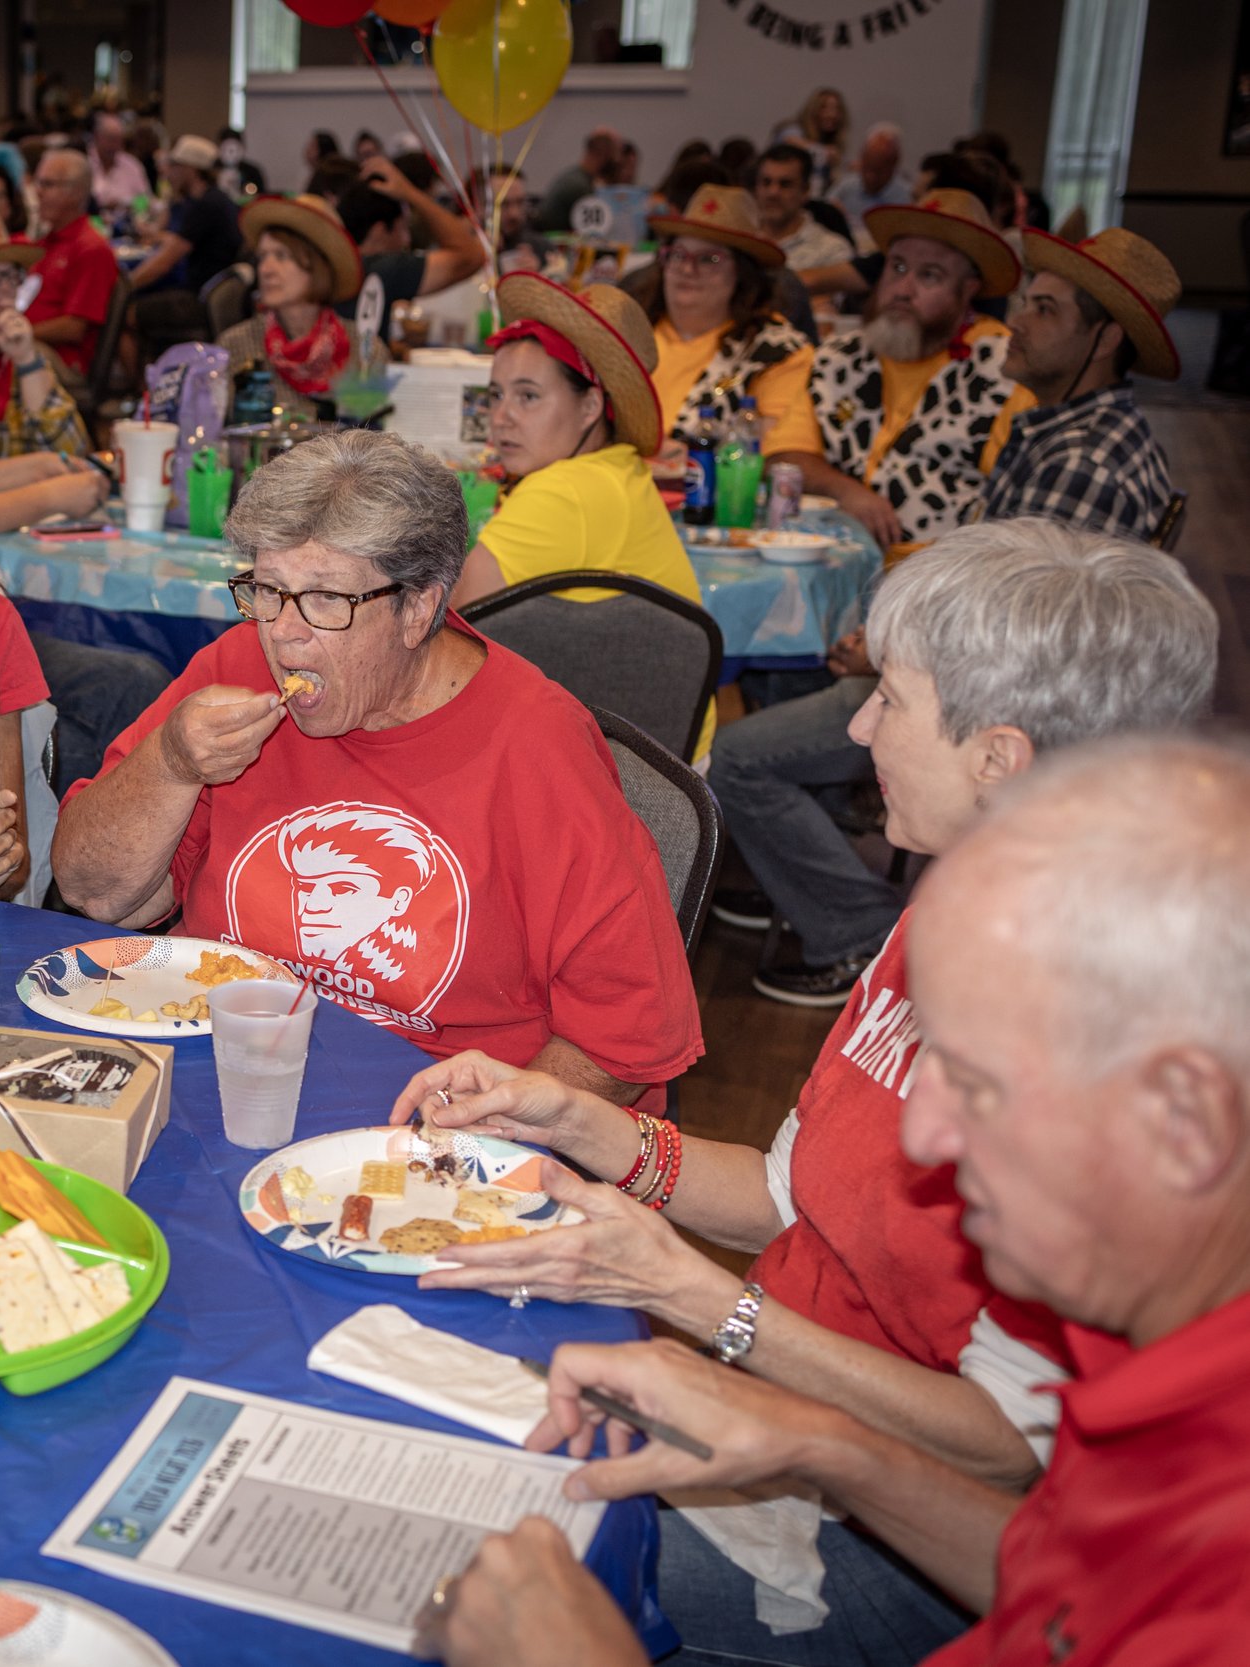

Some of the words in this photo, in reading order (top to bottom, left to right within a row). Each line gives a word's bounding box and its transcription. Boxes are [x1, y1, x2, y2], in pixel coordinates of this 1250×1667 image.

[832, 21, 852, 48] A
[170, 1483, 217, 1537] Answer
[205, 1437, 250, 1483] Sheets
